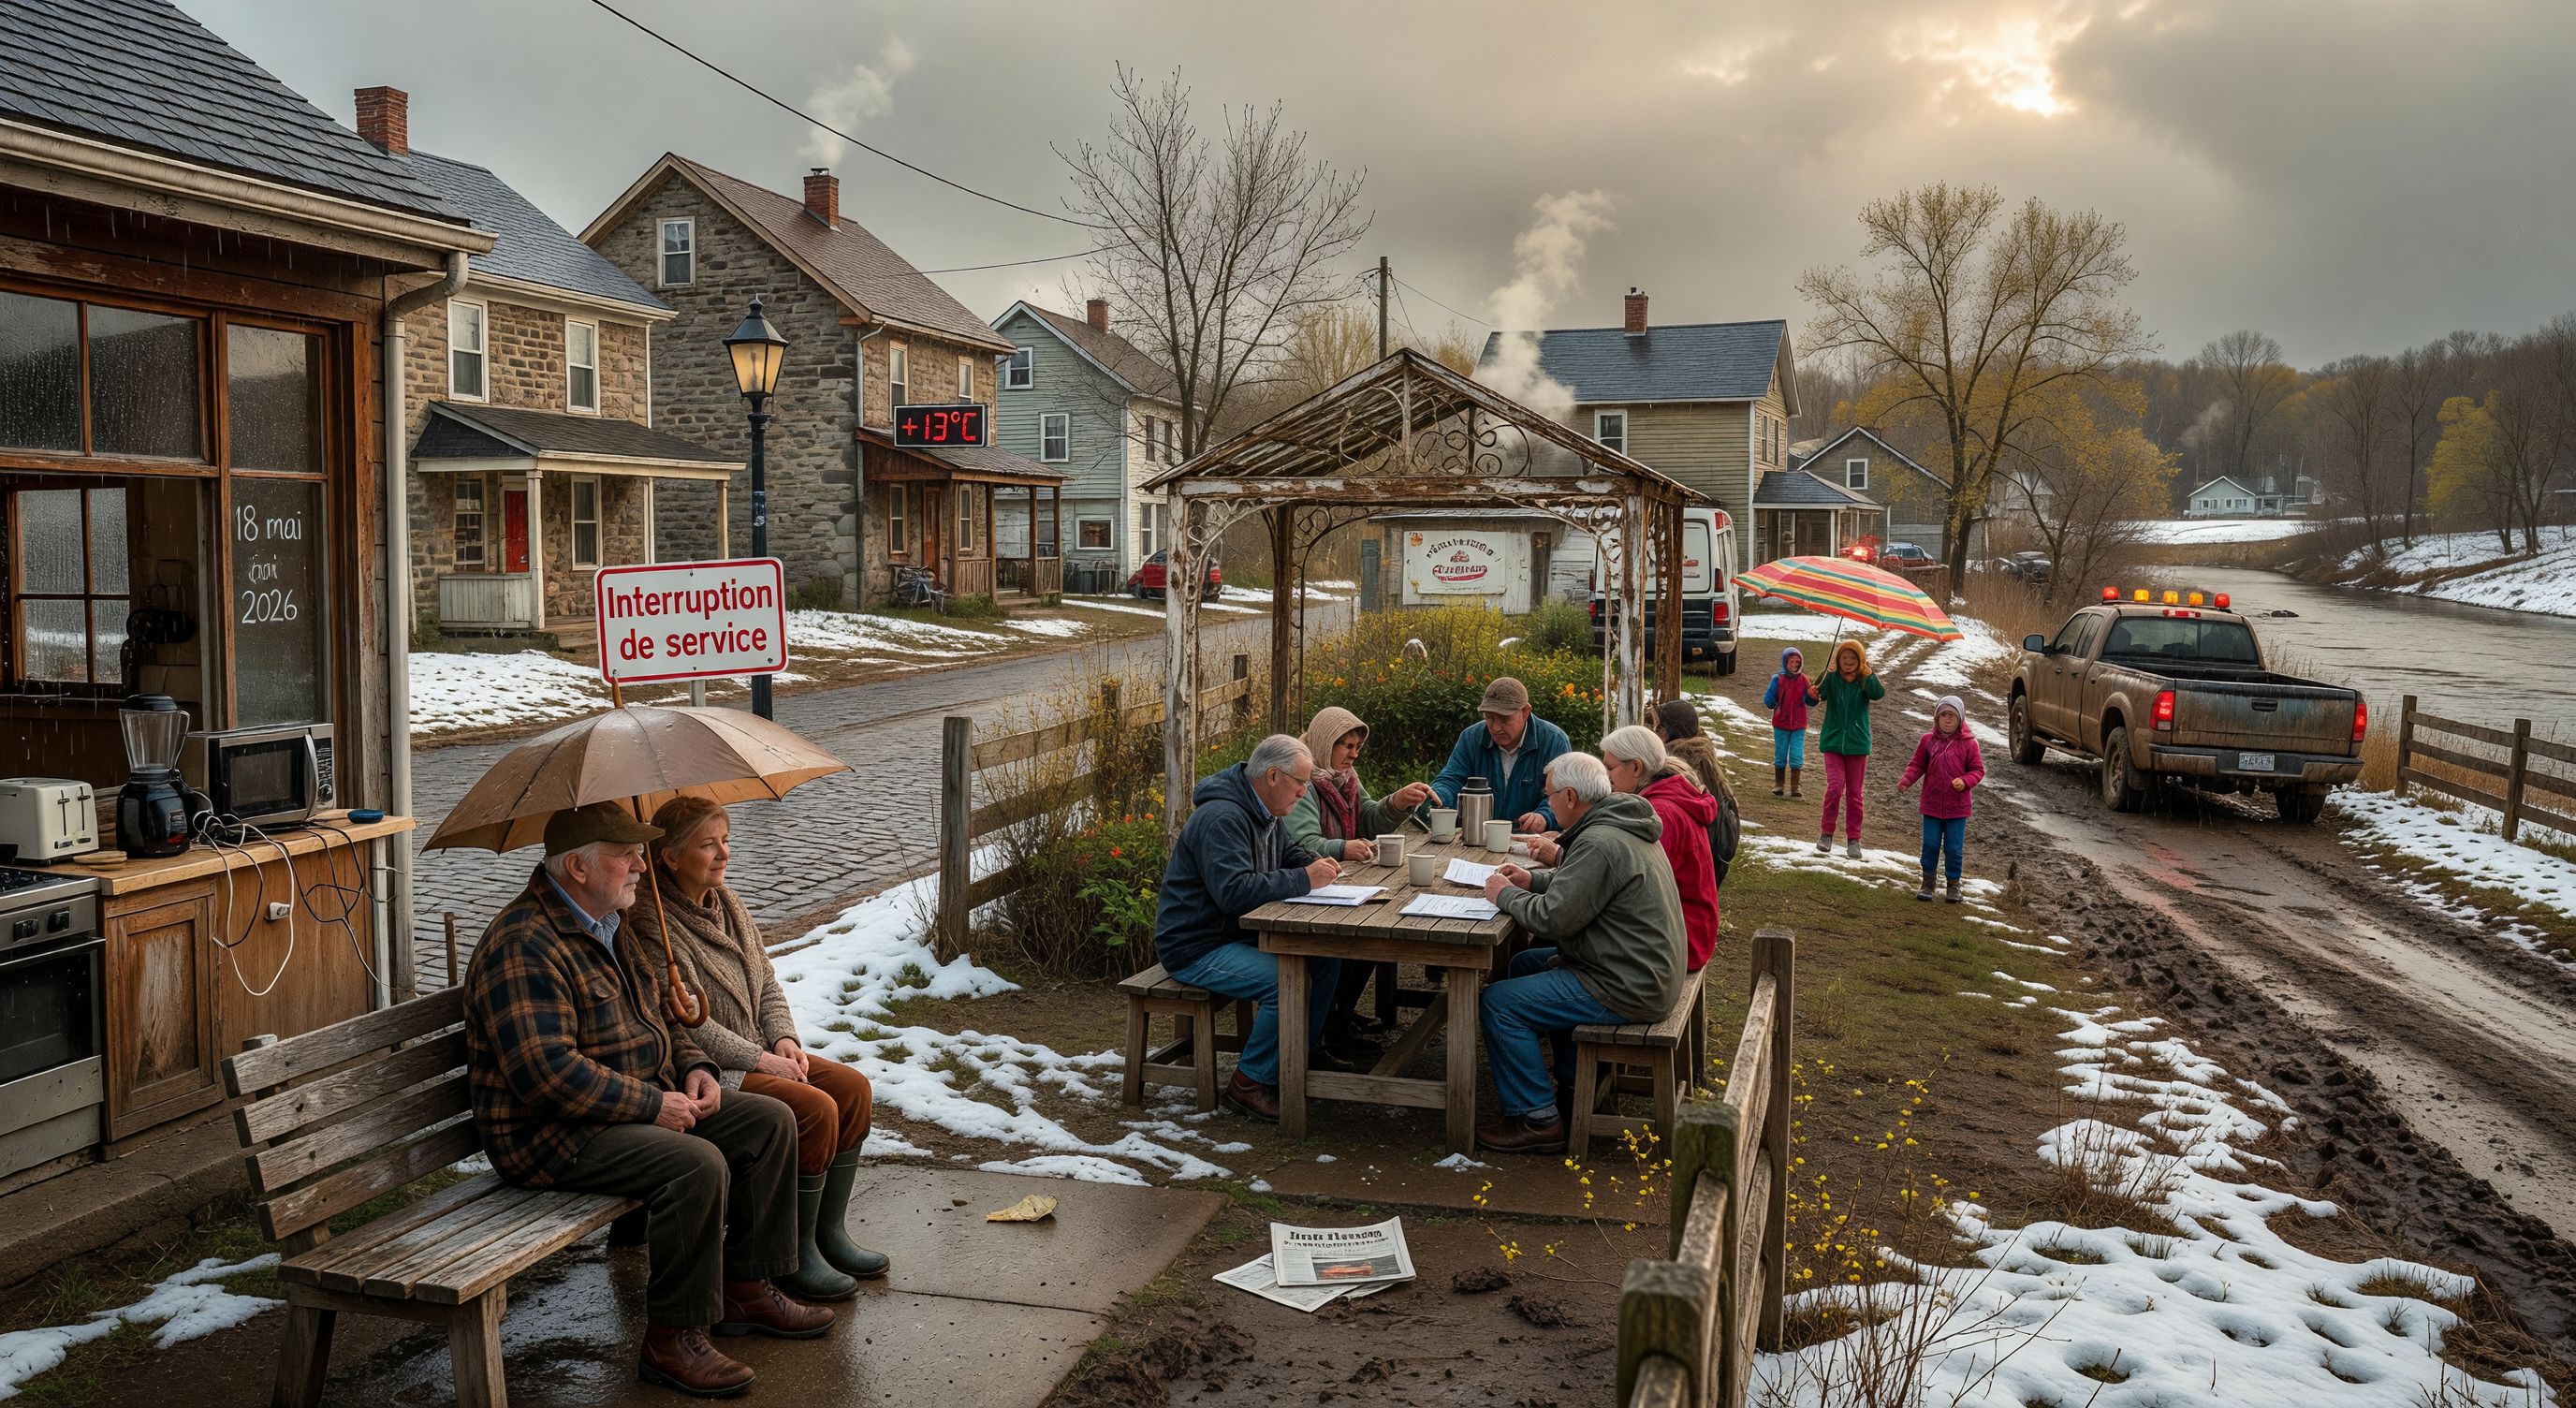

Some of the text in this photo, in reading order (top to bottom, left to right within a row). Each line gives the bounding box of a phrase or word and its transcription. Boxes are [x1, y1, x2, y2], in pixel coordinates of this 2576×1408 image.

[901, 410, 977, 442] +13°C
[235, 505, 301, 541] 18 mai
[242, 589, 298, 624] 2026
[607, 579, 773, 621] Interruption
[620, 622, 767, 660] de service
